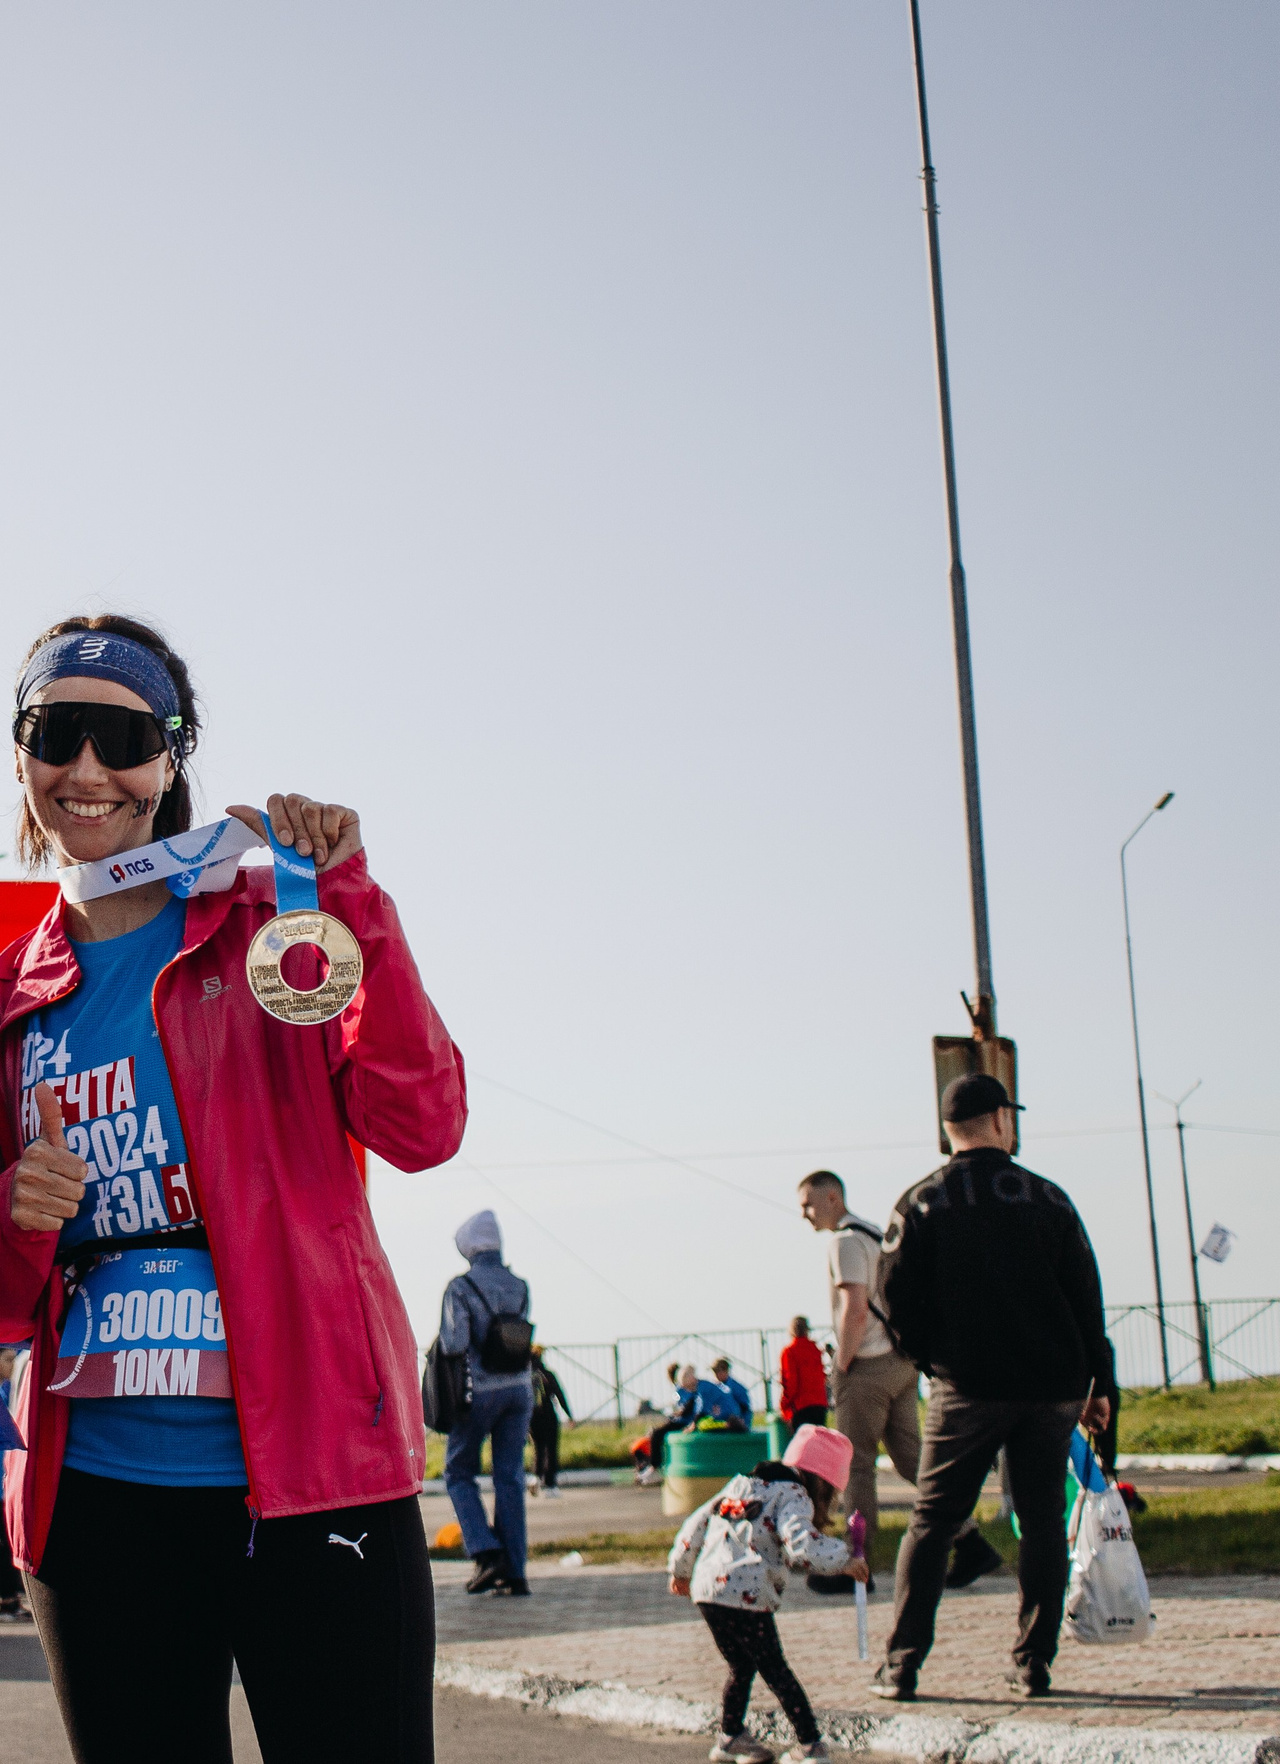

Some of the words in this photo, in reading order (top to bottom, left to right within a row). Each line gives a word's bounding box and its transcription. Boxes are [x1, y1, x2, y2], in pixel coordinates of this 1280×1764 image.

[124, 858, 155, 876] ПСБ
[99, 1288, 227, 1343] 30009
[113, 1349, 200, 1396] 10КМ
